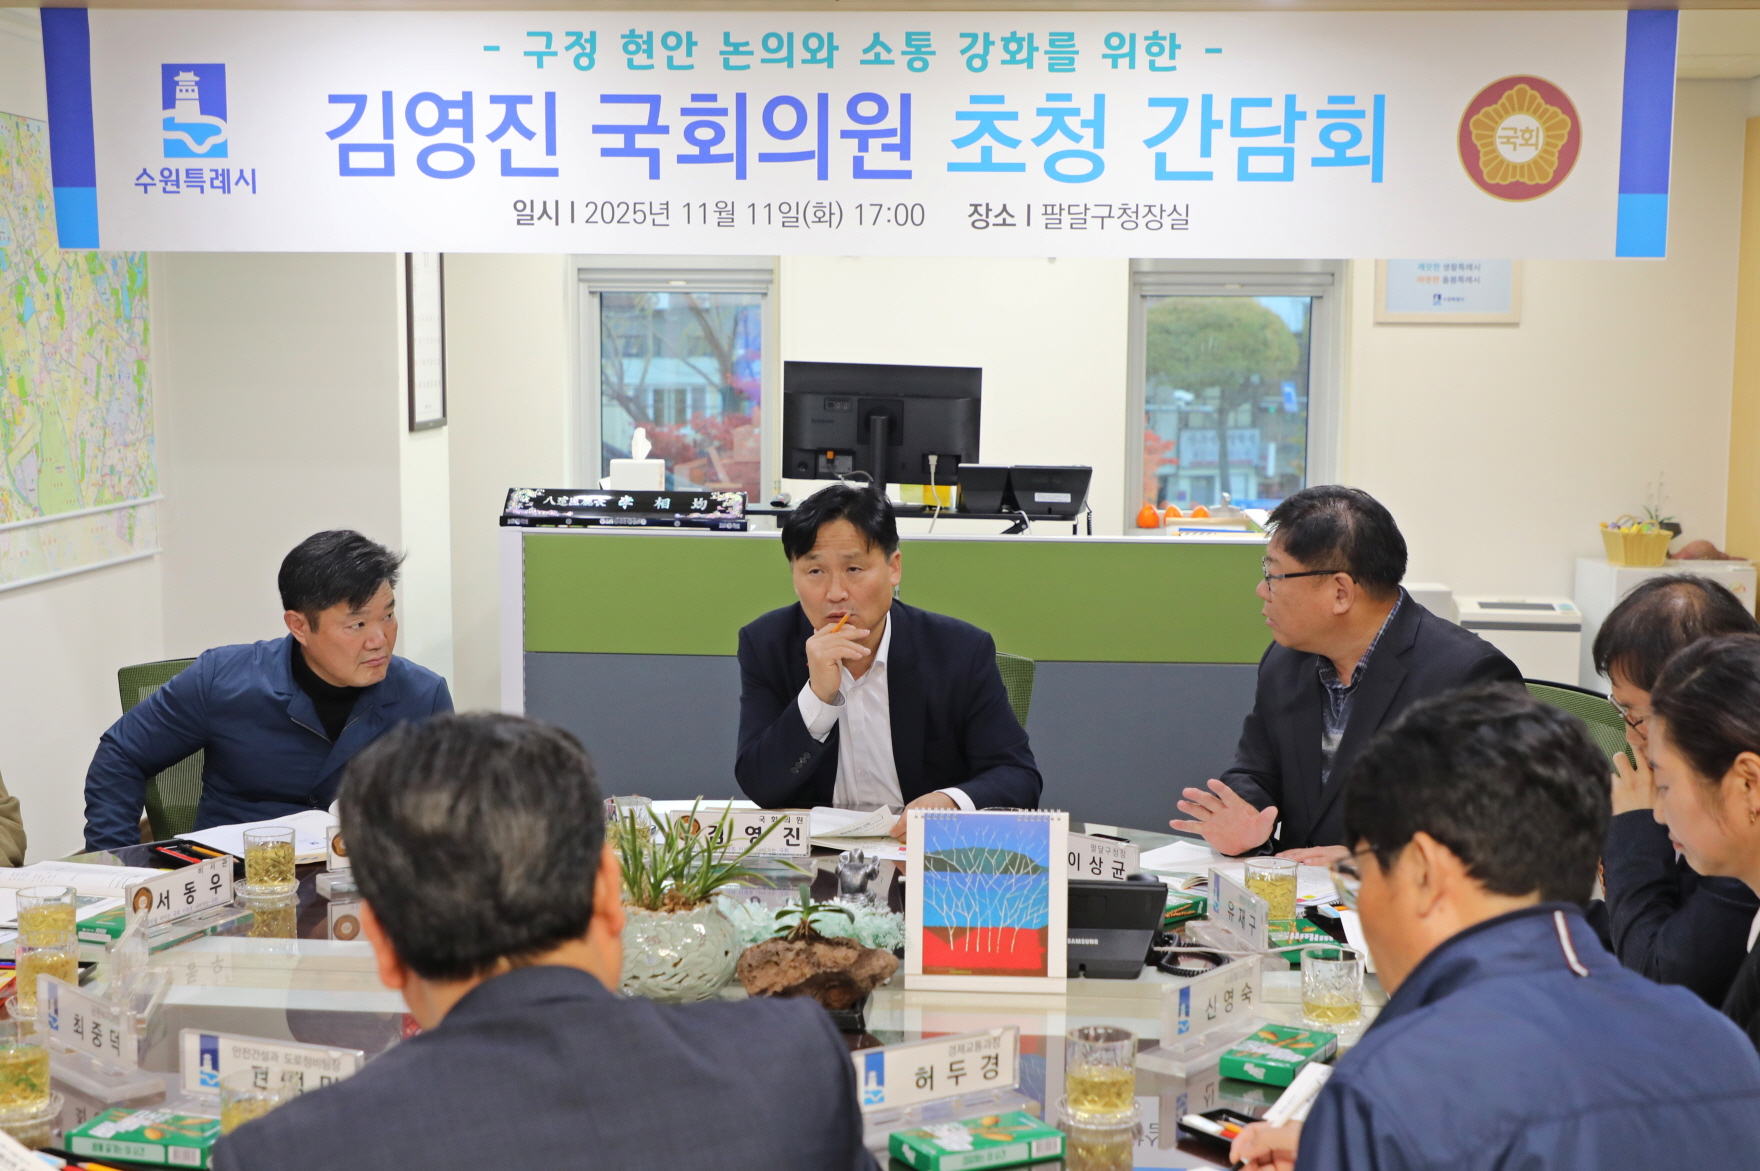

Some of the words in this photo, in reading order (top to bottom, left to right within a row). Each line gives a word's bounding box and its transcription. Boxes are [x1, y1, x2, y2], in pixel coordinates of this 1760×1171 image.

[523, 30, 598, 72] 구정
[620, 28, 699, 71] 현안
[718, 30, 840, 71] 논의와
[859, 31, 937, 73] 소통
[958, 31, 1080, 73] 강화를
[1101, 30, 1182, 73] 위한
[324, 91, 560, 179] 김영진
[591, 92, 913, 181] 국회의원
[946, 93, 1107, 184] 초청
[1142, 93, 1386, 184] 간담회
[1497, 126, 1540, 152] 국회
[134, 167, 257, 195] 수원특례시
[512, 199, 560, 227] 일시
[584, 200, 670, 227] 2025년
[682, 200, 735, 228] 11월
[747, 200, 844, 230] 11일(화)
[854, 202, 925, 227] 17:00
[967, 202, 1017, 231] 장소
[1041, 202, 1190, 232] 팔달구청장실
[1067, 851, 1126, 881] 이상균
[1090, 843, 1127, 859] 팔달구청장
[156, 873, 223, 911] 서동우
[1227, 900, 1256, 936] 유재구
[1067, 937, 1099, 945] SAMSUNG
[1205, 981, 1253, 1021] 신영숙
[73, 1013, 120, 1057] 최중덕
[914, 1052, 1000, 1092] 허두경
